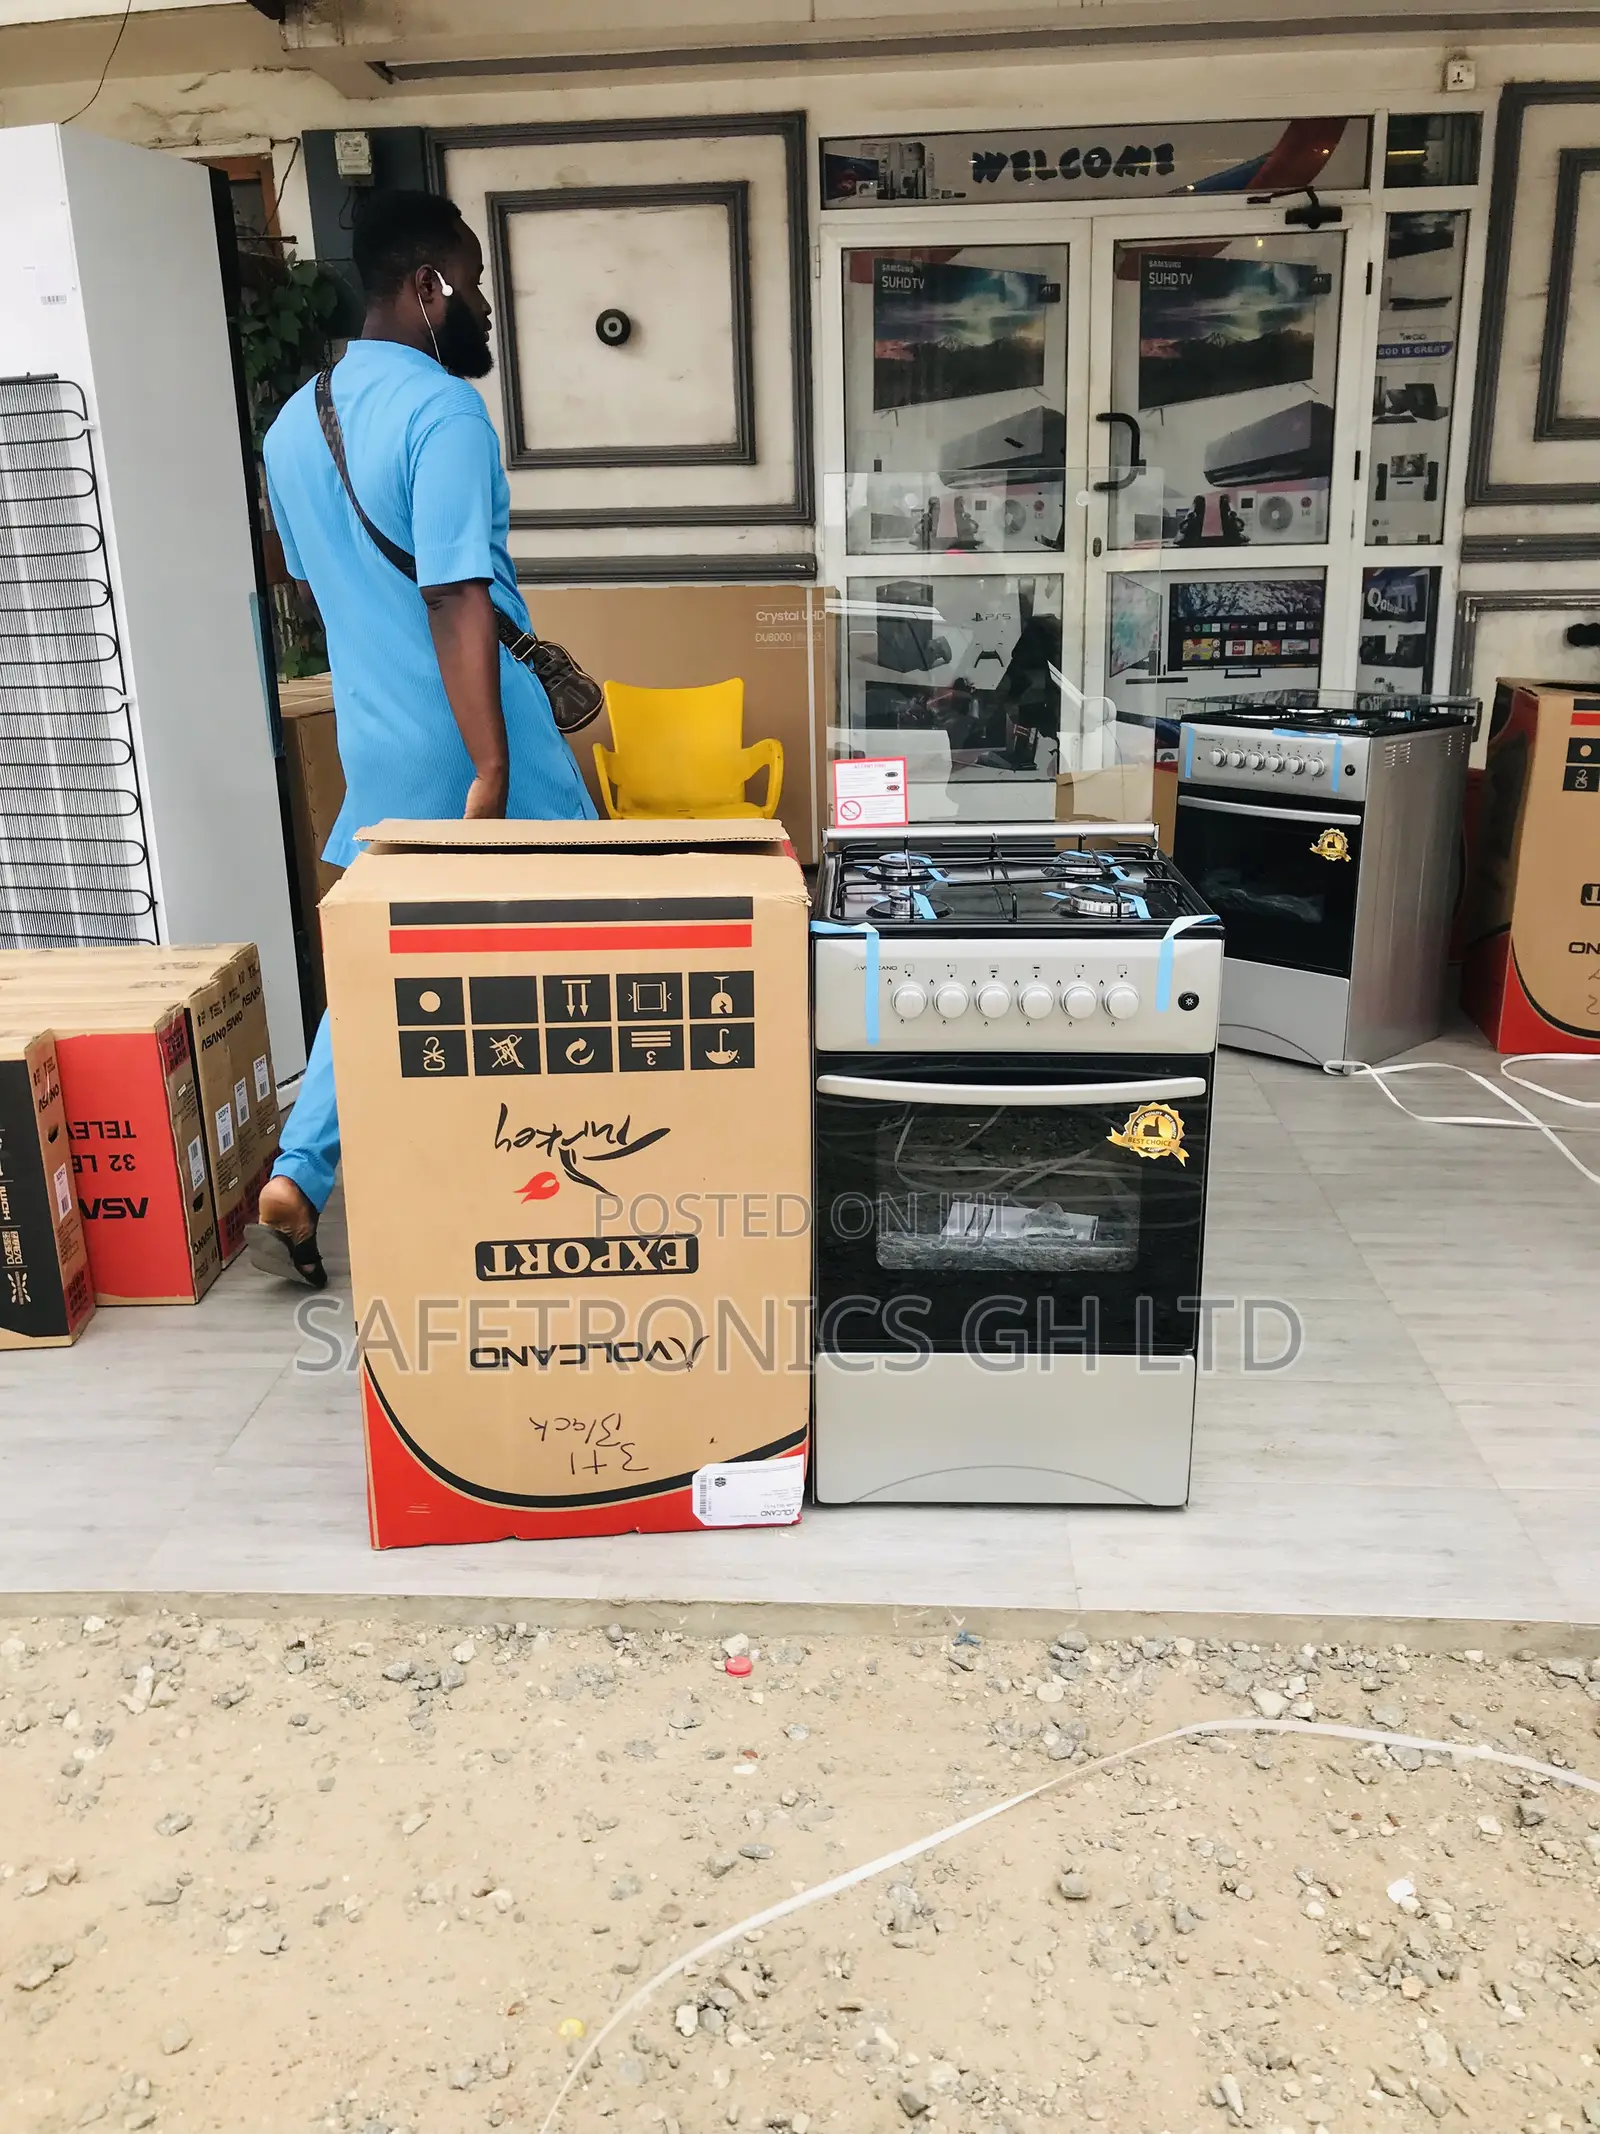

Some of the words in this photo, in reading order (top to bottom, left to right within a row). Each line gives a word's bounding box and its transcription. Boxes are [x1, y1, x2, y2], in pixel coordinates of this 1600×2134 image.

[972, 143, 1175, 183] WELCOME
[882, 264, 914, 273] SAMSUNG
[881, 275, 911, 289] SUHD
[912, 277, 925, 290] TV
[1148, 272, 1178, 285] SUHD
[1179, 273, 1193, 285] TV
[1414, 345, 1447, 354] GREAT
[755, 610, 800, 624] Crystal
[802, 610, 826, 621] UHD
[984, 612, 1012, 620] PS5
[755, 632, 792, 643] DU8000
[201, 1026, 227, 1052] ASANO
[1127, 1136, 1145, 1145] BEST
[1145, 1139, 1172, 1147] CHOICE
[109, 1153, 136, 1172] 32
[484, 1238, 691, 1277] EXPORT
[470, 1340, 673, 1368] VOLCANO
[529, 1413, 622, 1447] Black
